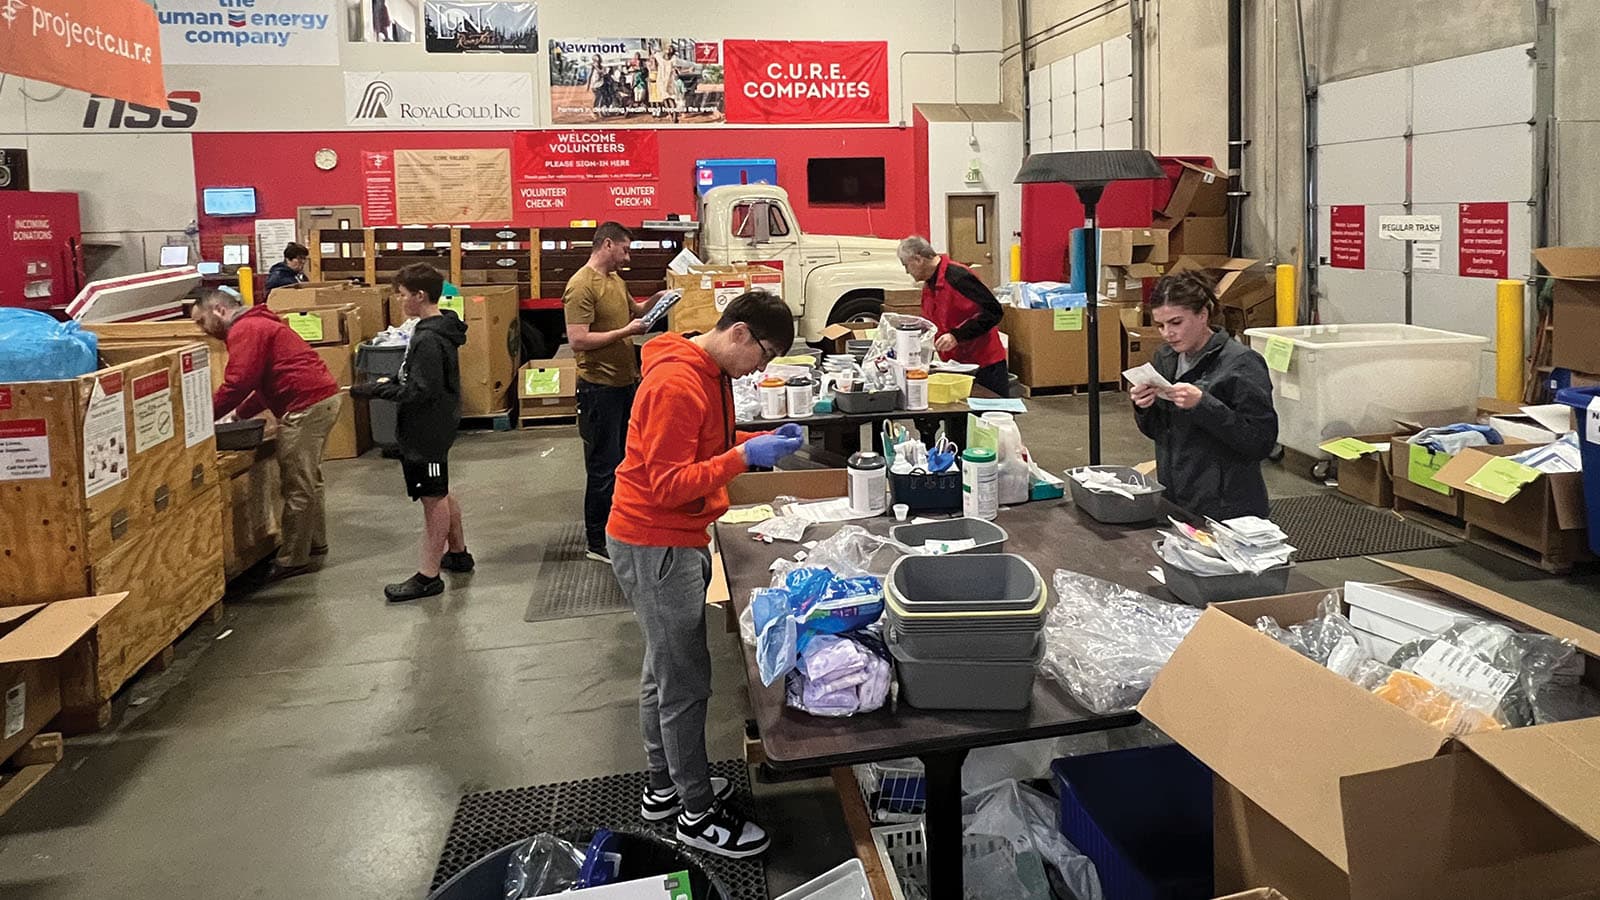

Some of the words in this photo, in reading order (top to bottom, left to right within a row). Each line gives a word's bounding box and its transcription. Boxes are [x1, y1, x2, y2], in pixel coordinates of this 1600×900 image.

[158, 11, 224, 25] uman
[250, 12, 329, 29] energy
[555, 41, 626, 54] Newmont
[767, 62, 847, 80] C.U.R.E.
[743, 81, 870, 99] COMPANIES
[557, 133, 616, 143] WELCOME
[549, 143, 625, 153] VOLUNTEERS
[545, 160, 574, 168] PLEASE
[575, 160, 609, 168] SIGN-IN
[610, 159, 630, 167] HERE
[520, 187, 567, 198] VOLUNTEER
[609, 186, 655, 197] VOLUNTEER
[525, 199, 564, 209] CHECK-IN
[614, 197, 652, 207] CHECK-IN
[1381, 223, 1414, 232] REGULAR
[1415, 223, 1440, 232] TRASH
[13, 230, 53, 241] DONATIONS
[1472, 257, 1494, 265] before
